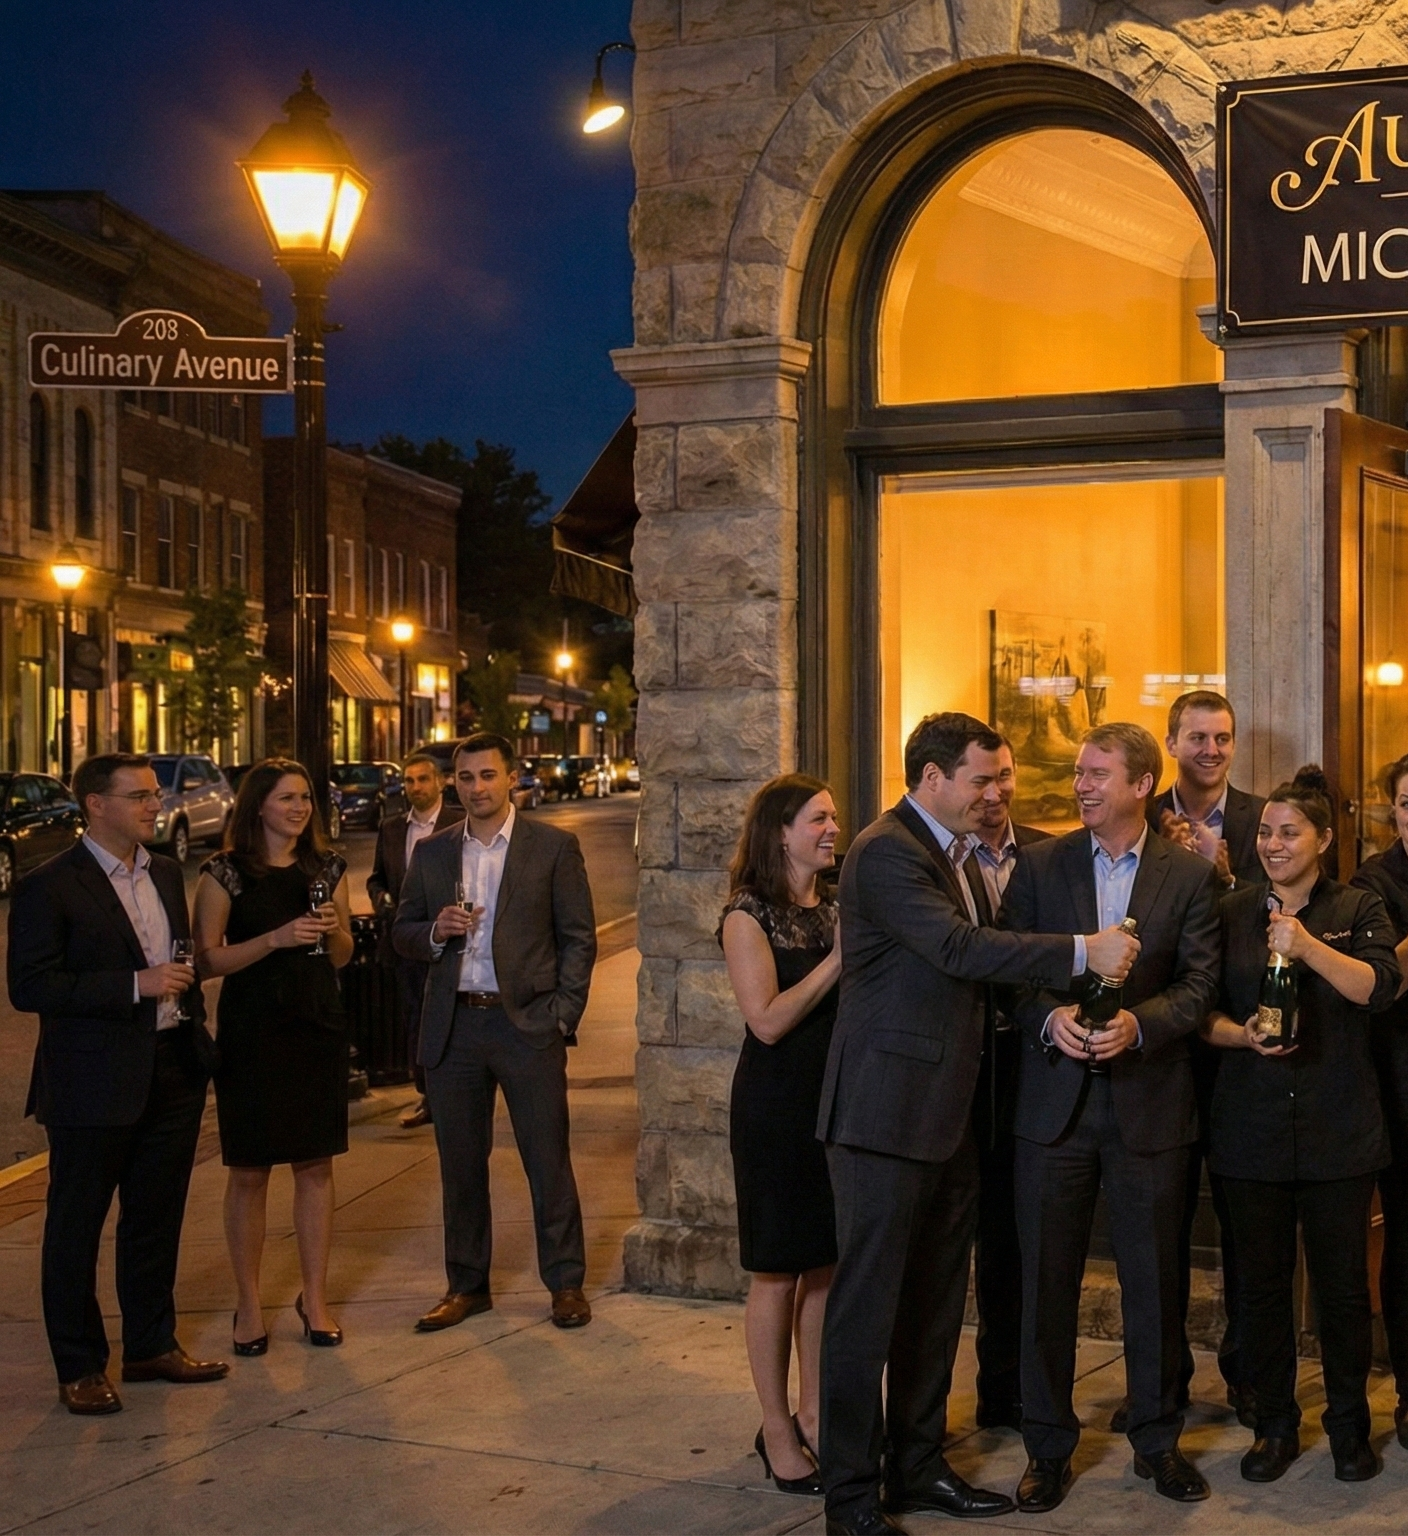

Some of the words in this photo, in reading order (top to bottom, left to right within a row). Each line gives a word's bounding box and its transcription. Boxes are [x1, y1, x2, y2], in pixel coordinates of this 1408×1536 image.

[142, 318, 179, 341] 208
[40, 342, 164, 386] Culinary
[173, 348, 280, 381] Avenue
